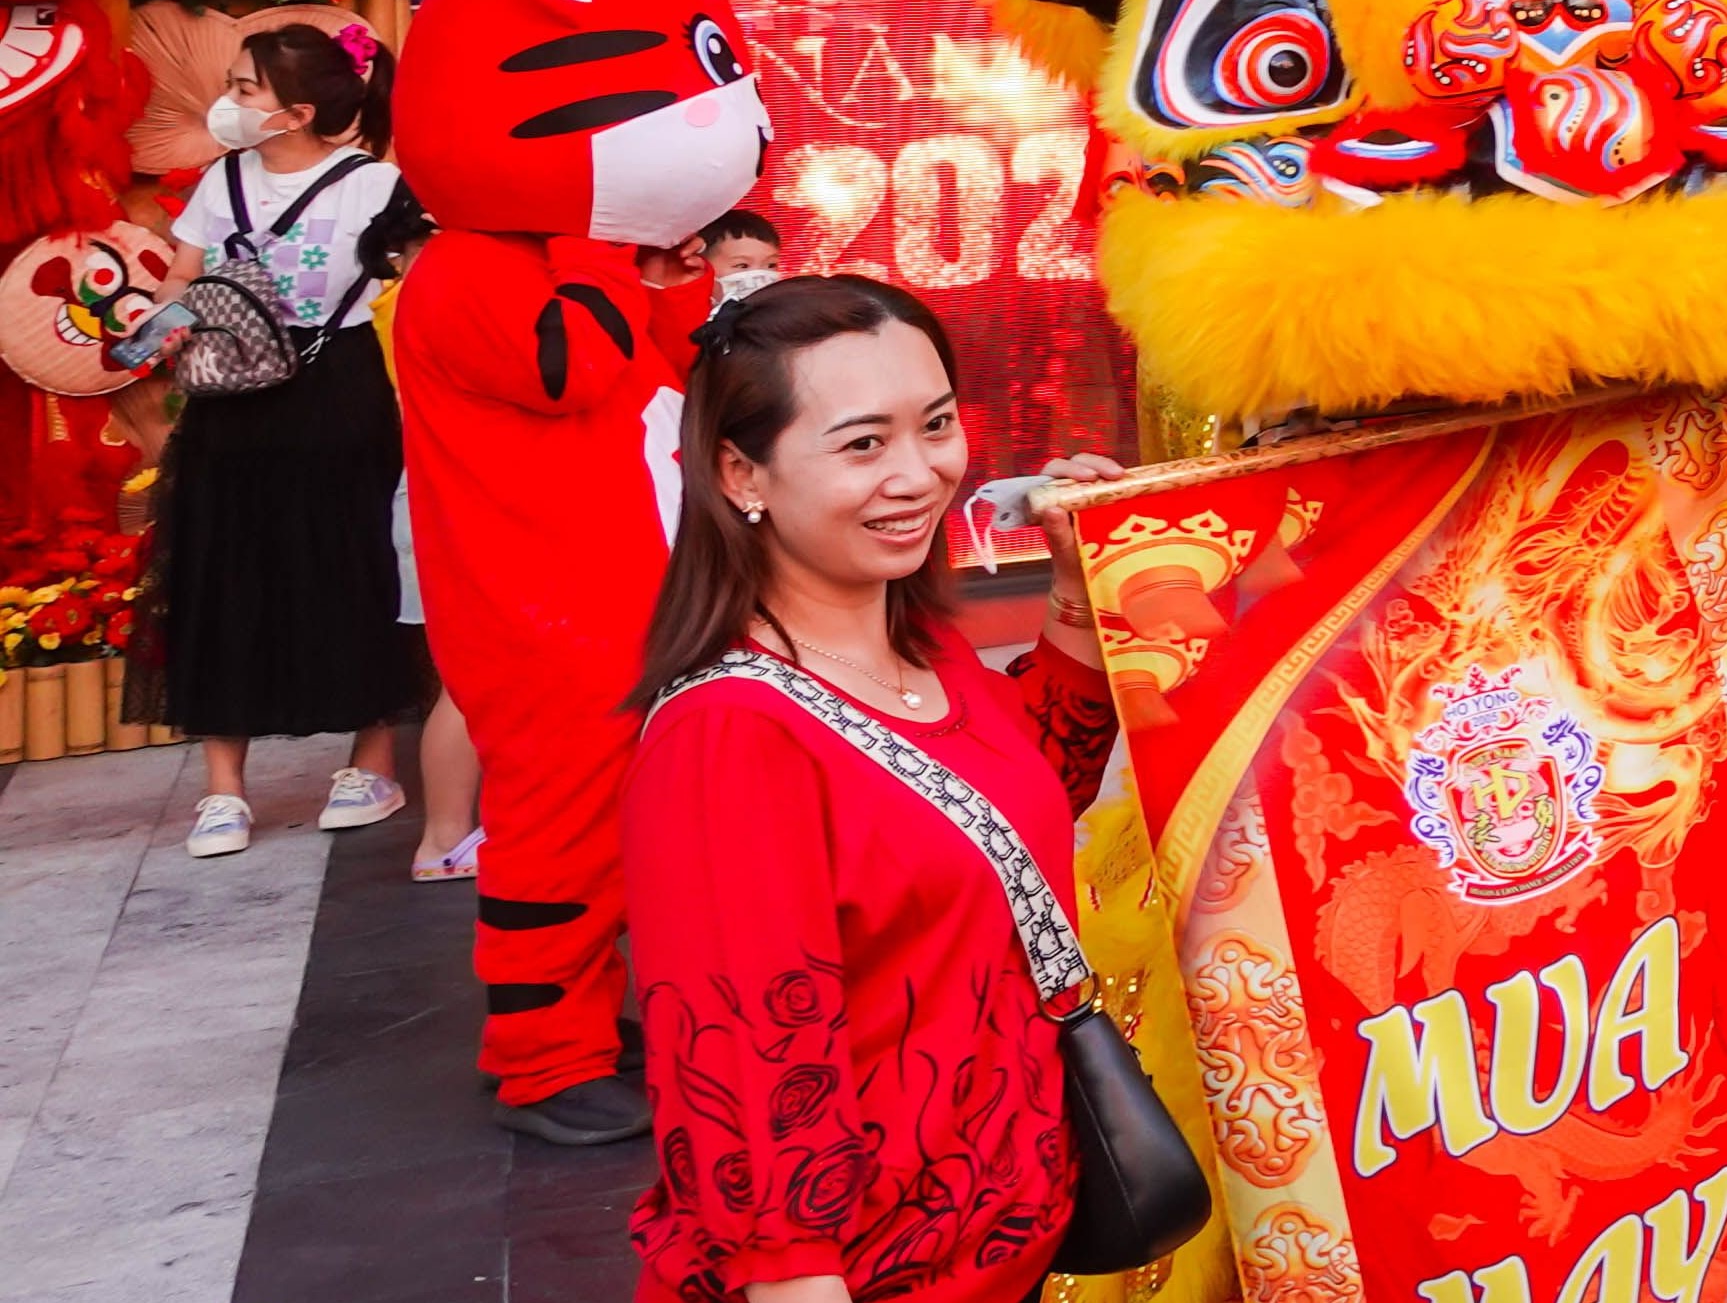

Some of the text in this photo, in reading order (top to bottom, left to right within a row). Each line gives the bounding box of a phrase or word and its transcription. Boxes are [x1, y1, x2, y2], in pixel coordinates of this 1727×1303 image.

[773, 133, 1092, 290] 202
[1472, 691, 1520, 711] YONG
[1353, 914, 1691, 1178] MUA
